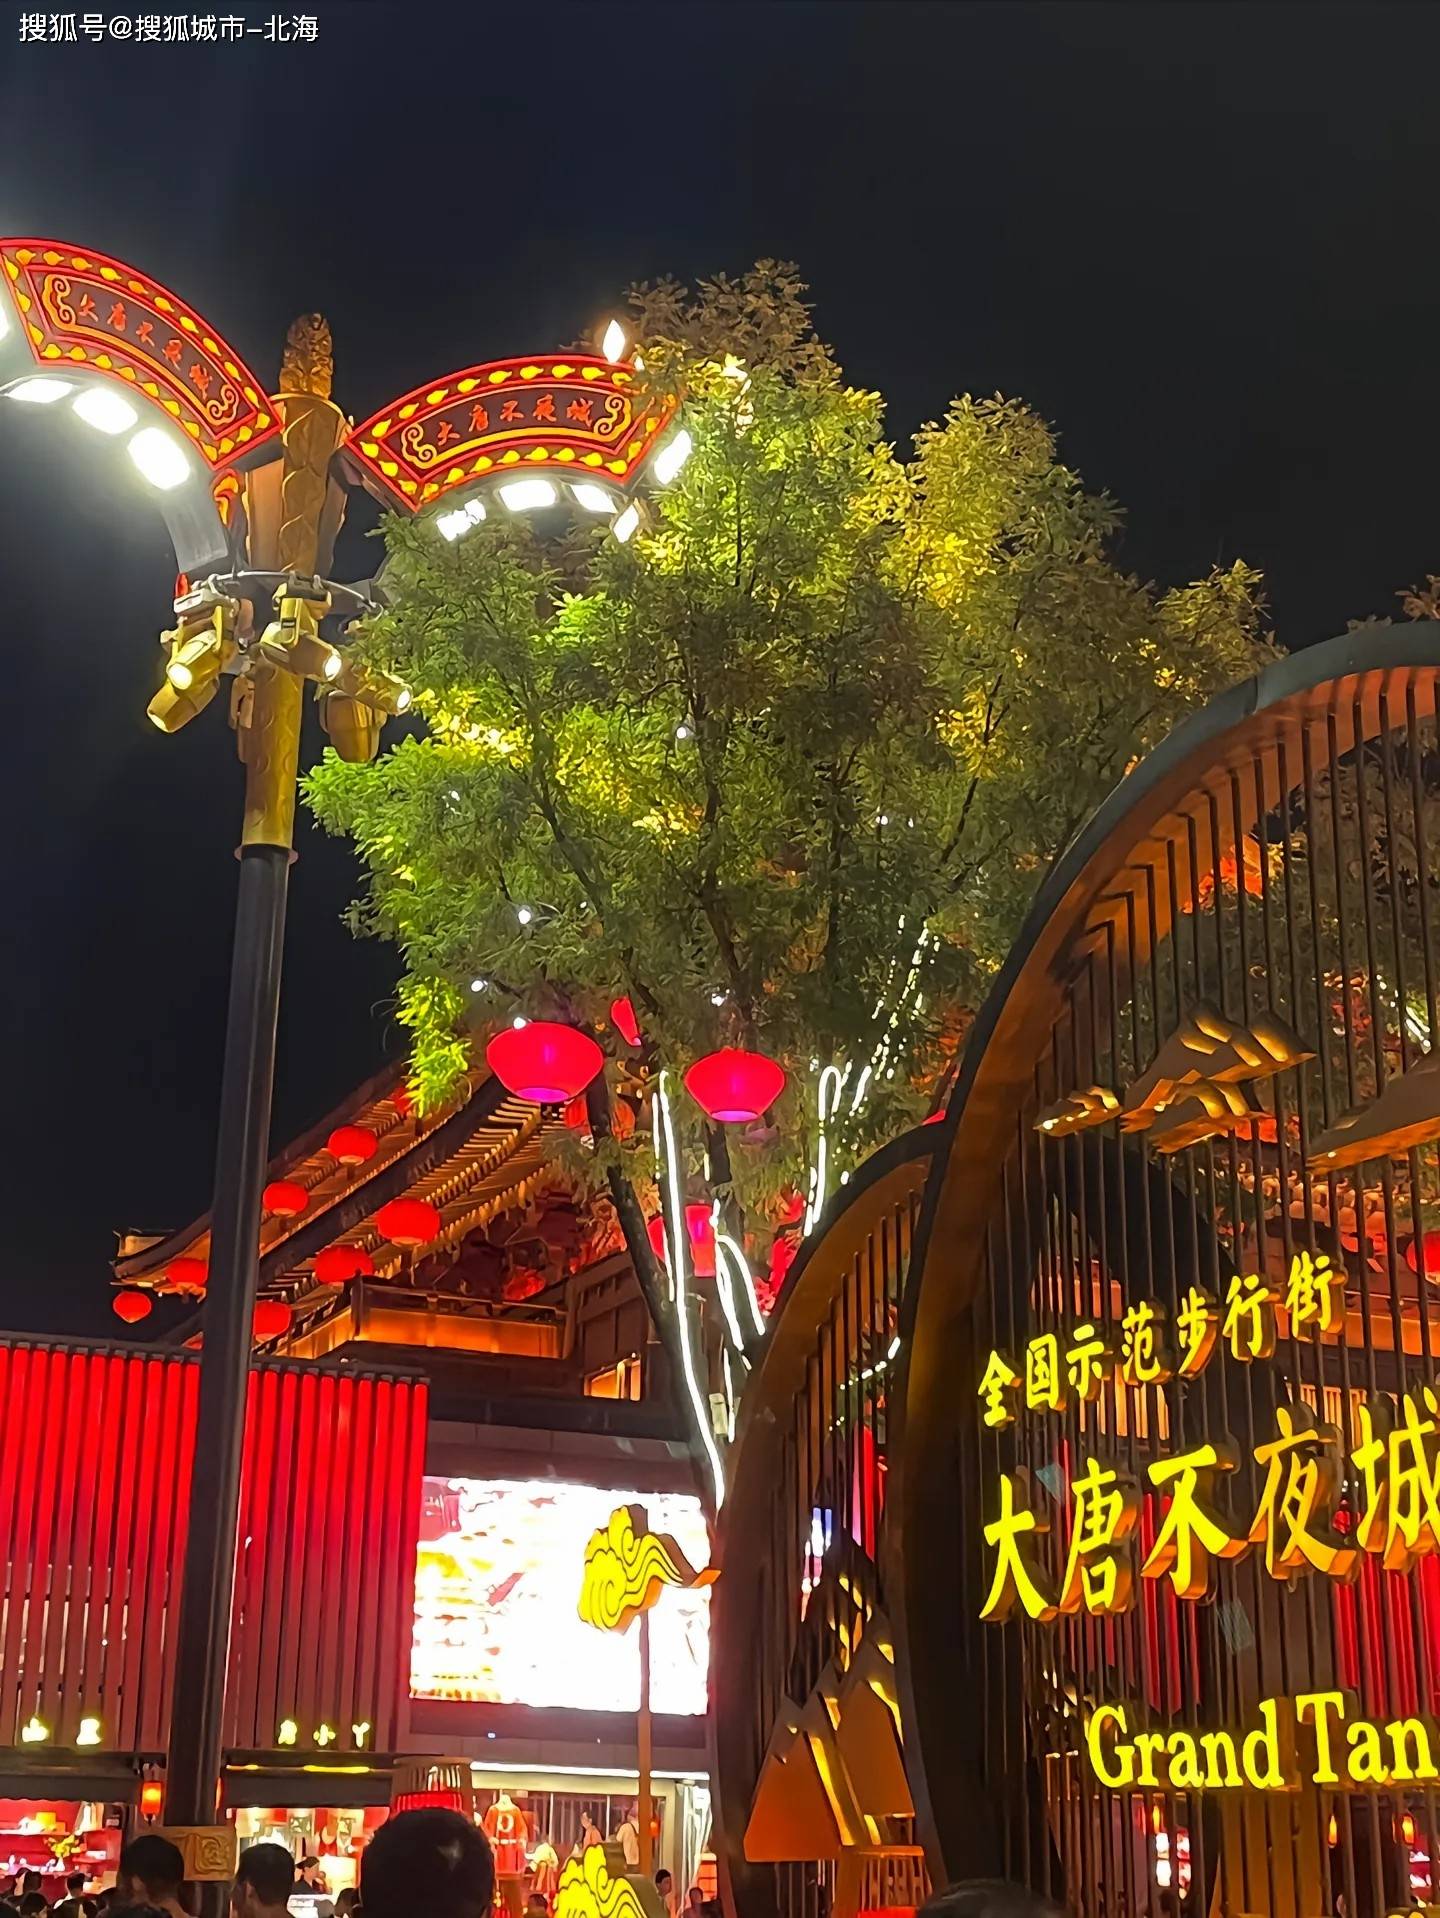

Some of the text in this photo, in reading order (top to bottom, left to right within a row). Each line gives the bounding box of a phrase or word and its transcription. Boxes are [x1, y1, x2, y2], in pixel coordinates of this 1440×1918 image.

[977, 1250, 1335, 1427] 全国示范步行街
[979, 1386, 1440, 1620] 大唐不夜城
[1085, 1691, 1440, 1789] Grand Tan
